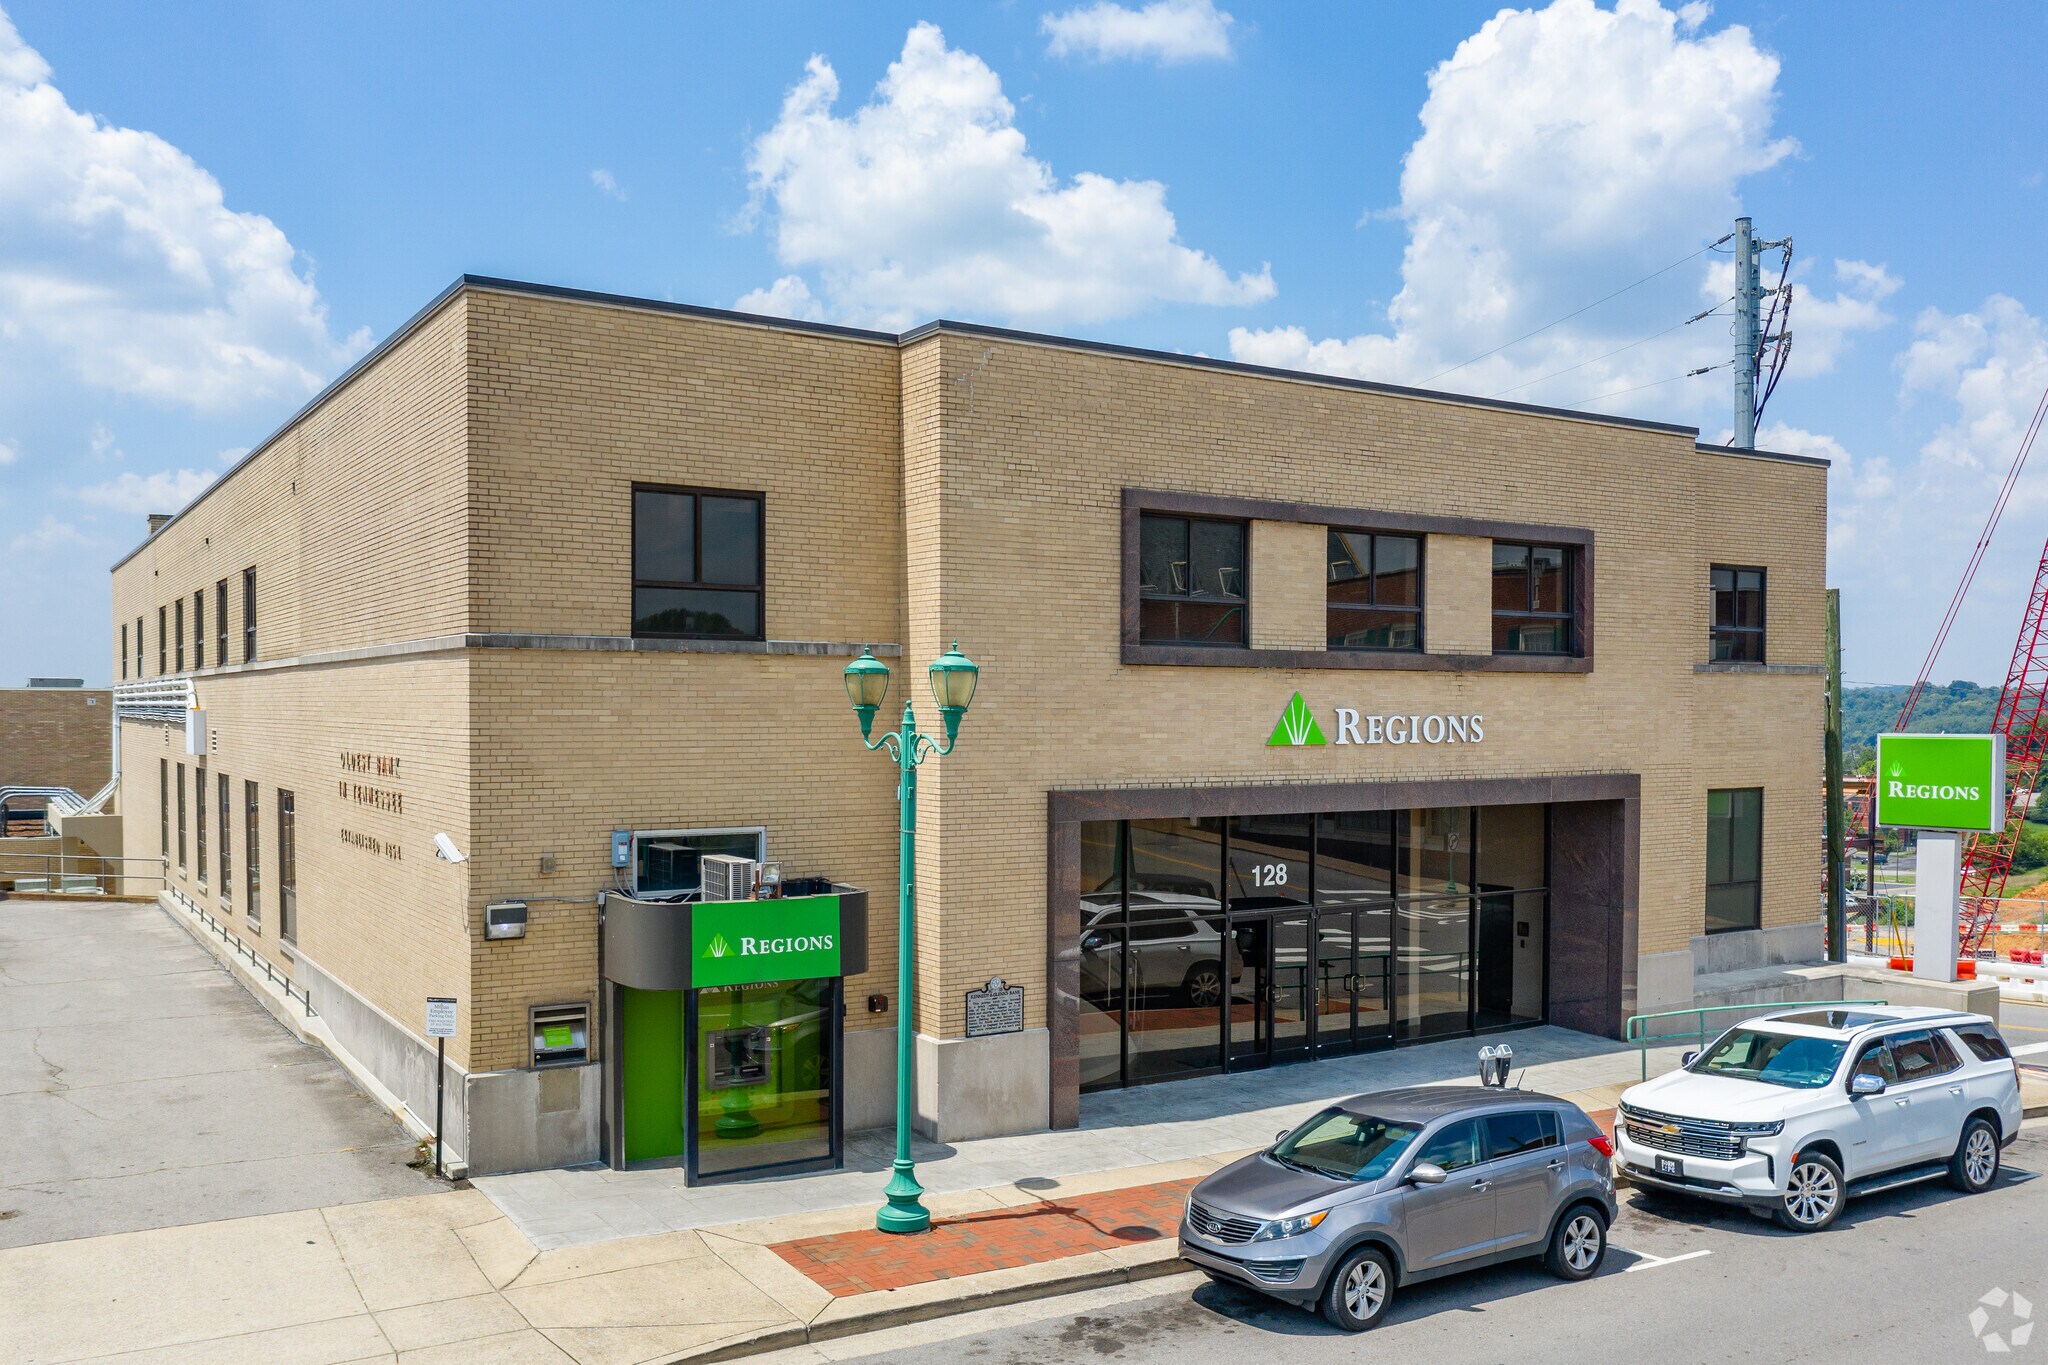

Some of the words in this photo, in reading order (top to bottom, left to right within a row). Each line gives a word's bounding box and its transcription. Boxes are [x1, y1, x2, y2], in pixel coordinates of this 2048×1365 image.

[1334, 707, 1484, 745] REGIONS
[1888, 780, 1980, 801] REGIONS
[1251, 863, 1288, 887] 128
[740, 934, 833, 956] REGIONS
